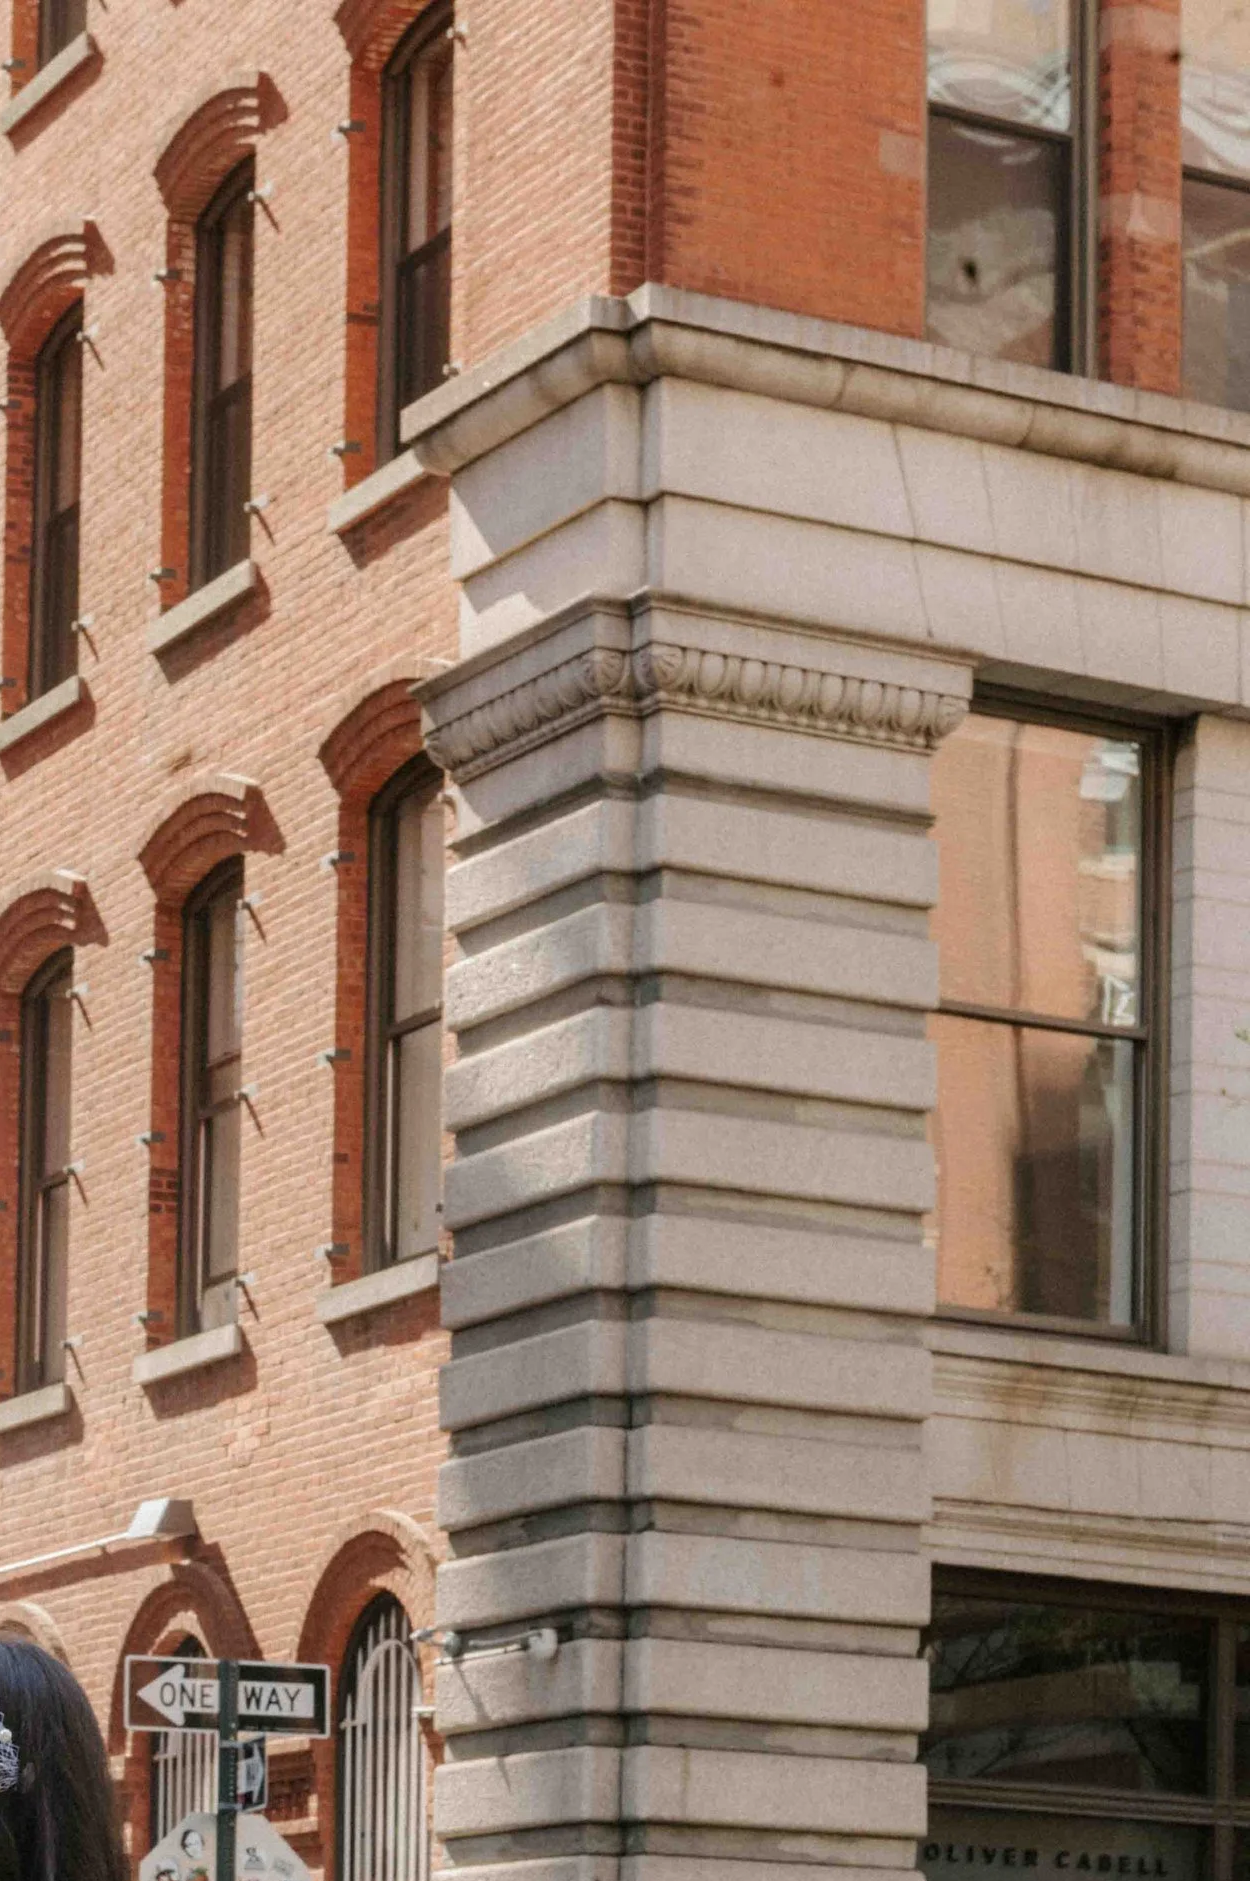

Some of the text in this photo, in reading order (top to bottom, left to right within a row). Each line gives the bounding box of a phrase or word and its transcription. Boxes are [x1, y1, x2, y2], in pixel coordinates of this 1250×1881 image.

[159, 1681, 302, 1712] ONE WAY
[923, 1843, 1169, 1878] OLIVER CABELL
